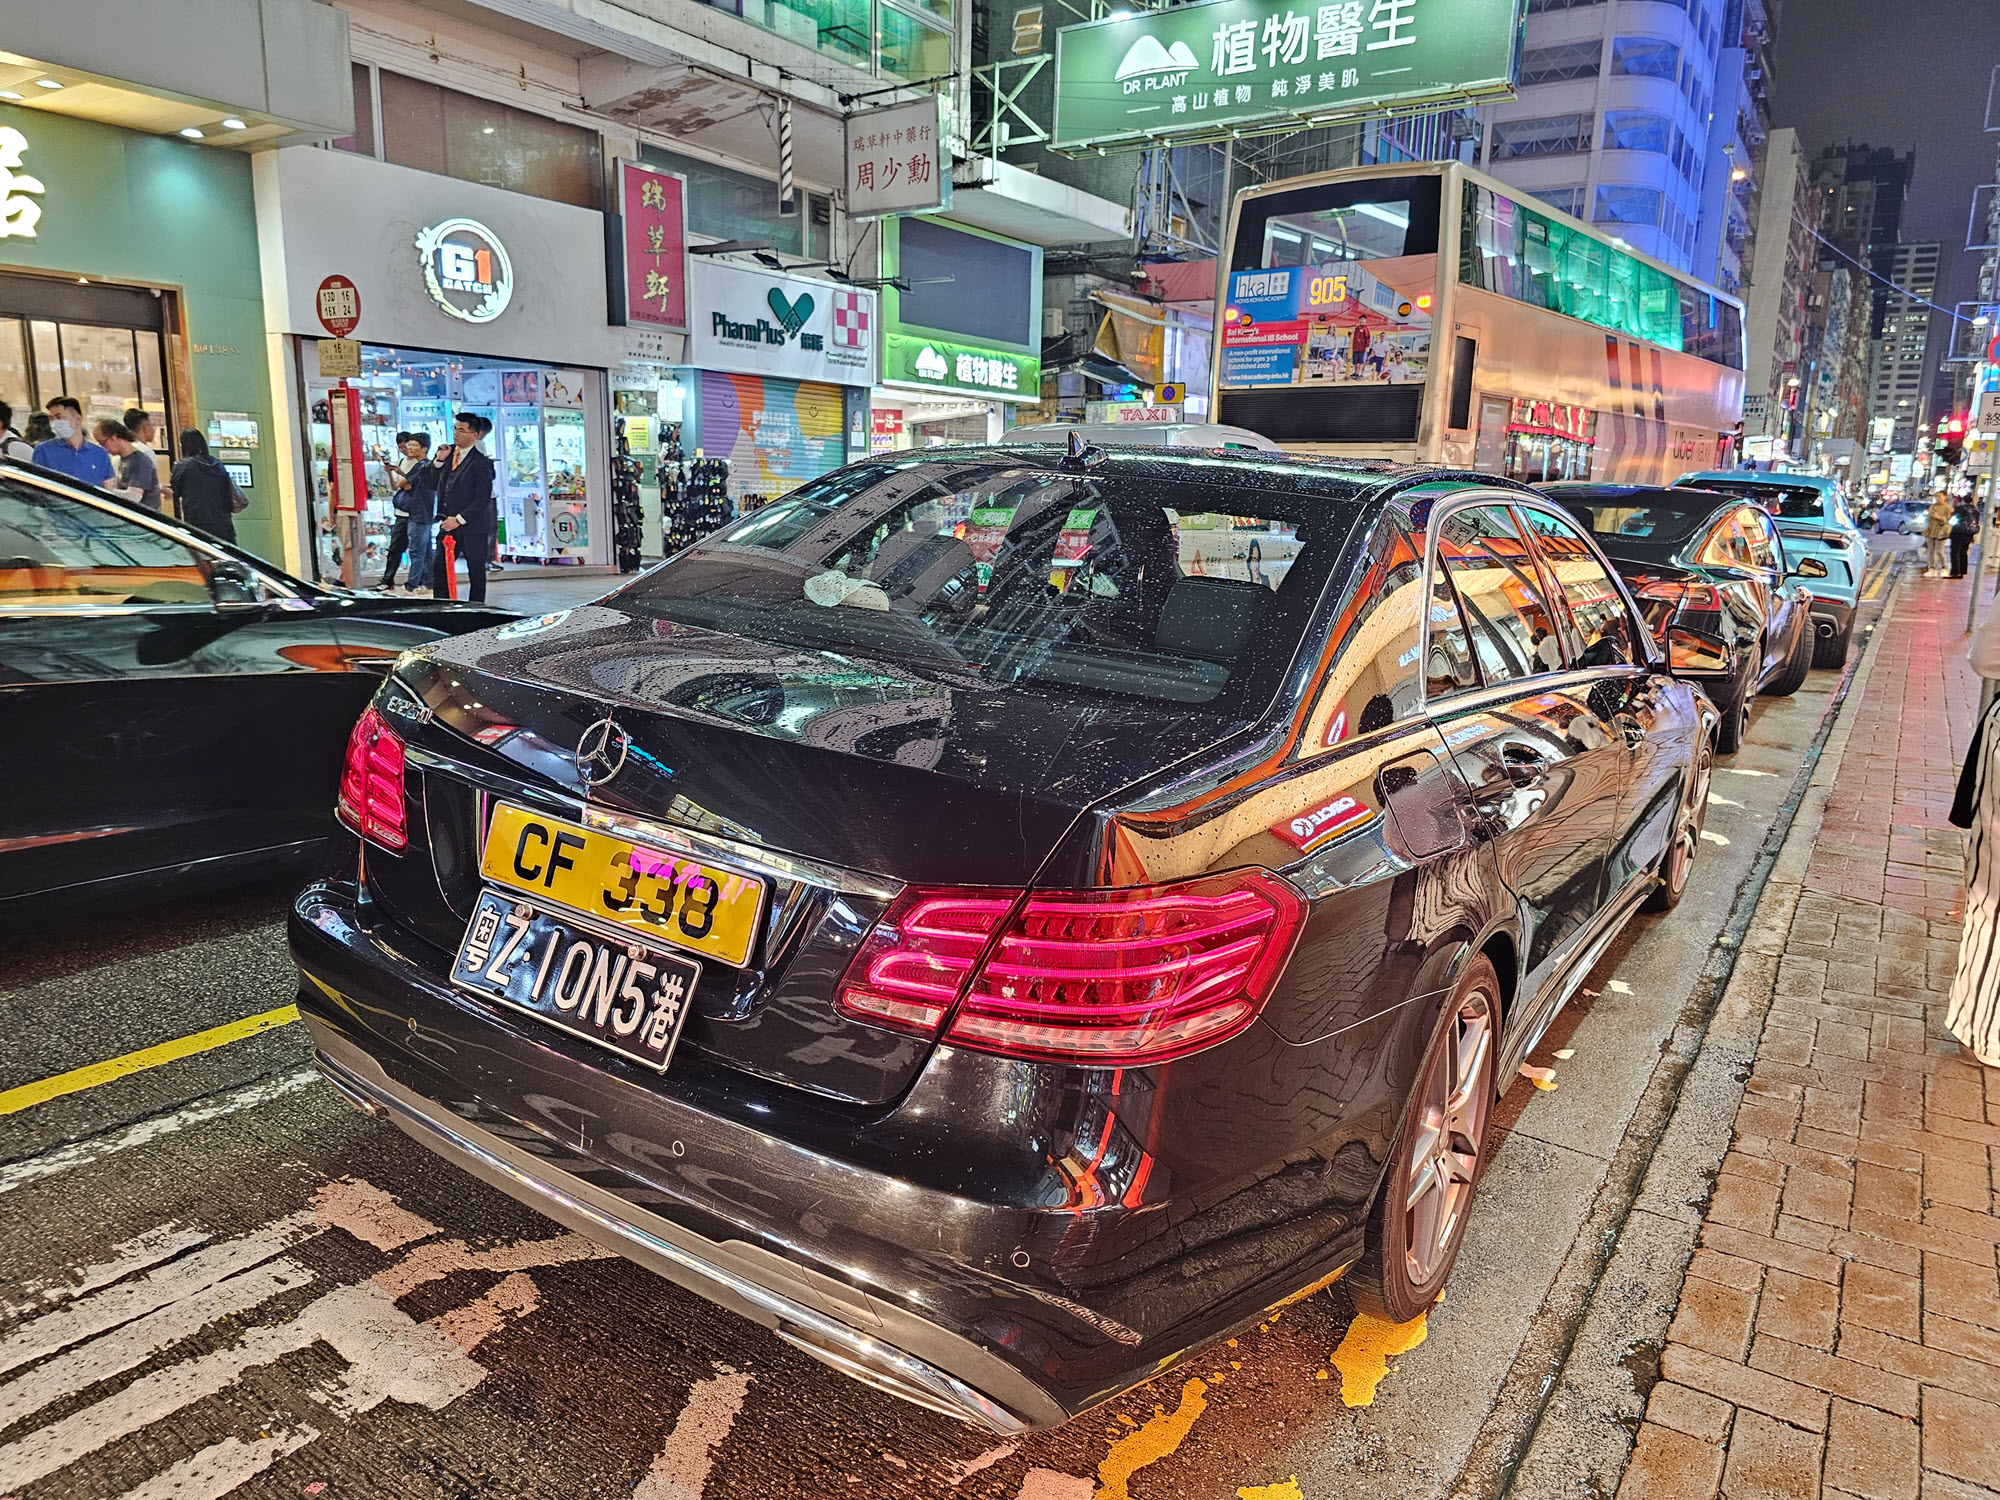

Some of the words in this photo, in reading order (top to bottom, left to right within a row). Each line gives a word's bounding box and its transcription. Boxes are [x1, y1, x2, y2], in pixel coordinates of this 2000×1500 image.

[1210, 0, 1416, 77] 植物醫生
[1123, 80, 1141, 95] DR
[1144, 72, 1189, 91] PLANT
[1171, 84, 1252, 115] 高山植物
[1271, 67, 1359, 98] 純淨美肌
[853, 124, 932, 152] 瑞草軒中藥行
[855, 152, 931, 192] 周少勳
[641, 178, 670, 314] 瑞草軒
[441, 242, 492, 285] G1
[323, 291, 335, 302] 13D
[341, 290, 350, 301] 16
[442, 278, 492, 295] CATCH
[1310, 276, 1347, 306] 905
[324, 306, 337, 317] 16X
[343, 305, 351, 316] 24
[712, 311, 785, 346] PharmPlus
[1226, 335, 1267, 344] International
[1267, 334, 1275, 342] IB
[1275, 333, 1298, 341] School
[1227, 328, 1237, 336] Sai
[333, 342, 342, 354] 16
[1265, 355, 1278, 363] 3-18
[955, 353, 1018, 390] 植物醫生
[1120, 408, 1167, 421] TAXI
[513, 822, 586, 889] CF
[602, 850, 720, 940] 338
